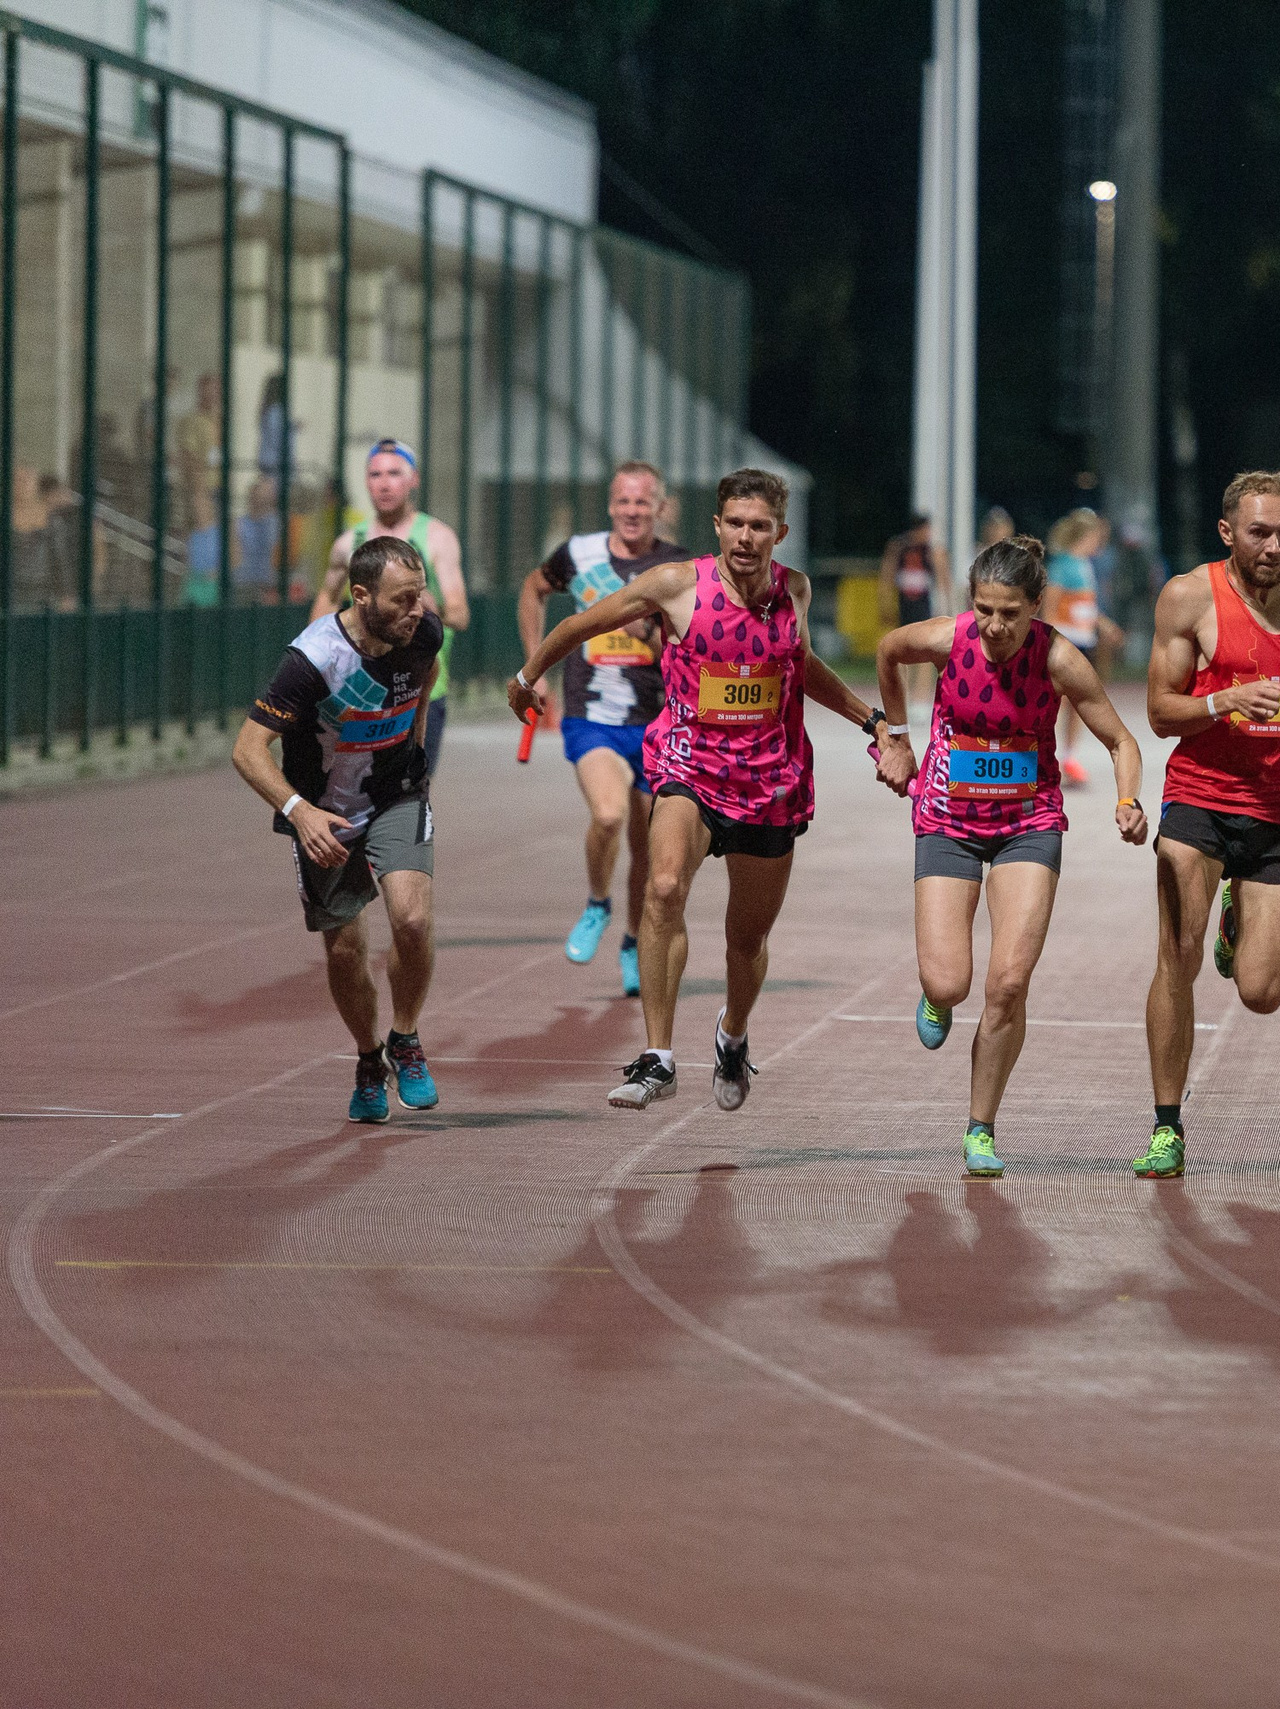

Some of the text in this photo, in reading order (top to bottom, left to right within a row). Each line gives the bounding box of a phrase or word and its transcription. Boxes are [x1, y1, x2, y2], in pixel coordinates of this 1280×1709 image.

[393, 672, 411, 683] бег
[393, 683, 407, 693] на
[724, 684, 774, 704] 309 2
[365, 720, 395, 738] 310
[974, 758, 1028, 778] 309 3
